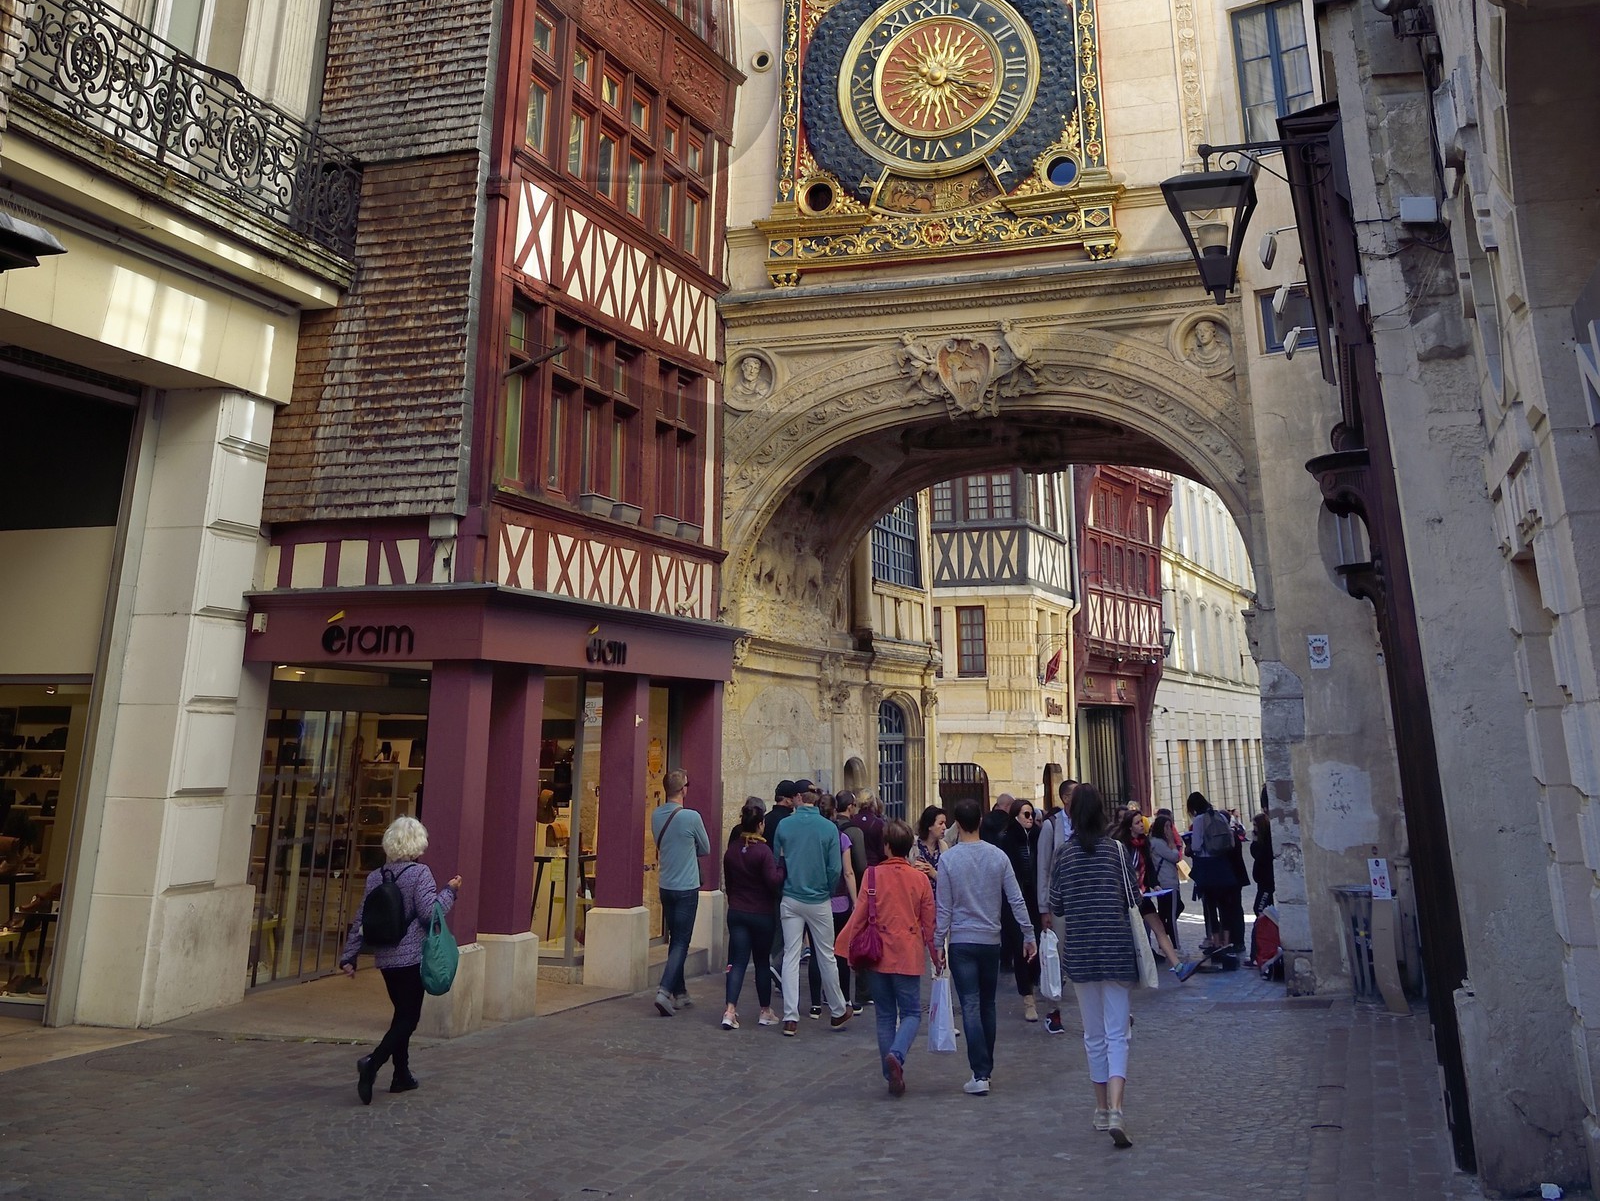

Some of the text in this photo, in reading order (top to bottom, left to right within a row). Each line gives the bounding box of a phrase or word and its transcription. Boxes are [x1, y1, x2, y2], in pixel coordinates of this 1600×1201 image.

[882, 7, 913, 37] XI
[968, 2, 982, 20] I
[991, 23, 1016, 43] II
[860, 38, 885, 61] X
[1005, 56, 1027, 79] III
[852, 74, 873, 100] IX
[990, 90, 1022, 122] IIII
[855, 103, 886, 142] VIII
[880, 131, 912, 160] VII
[922, 139, 952, 161] VI
[970, 127, 992, 149] V
[322, 610, 415, 654] éram
